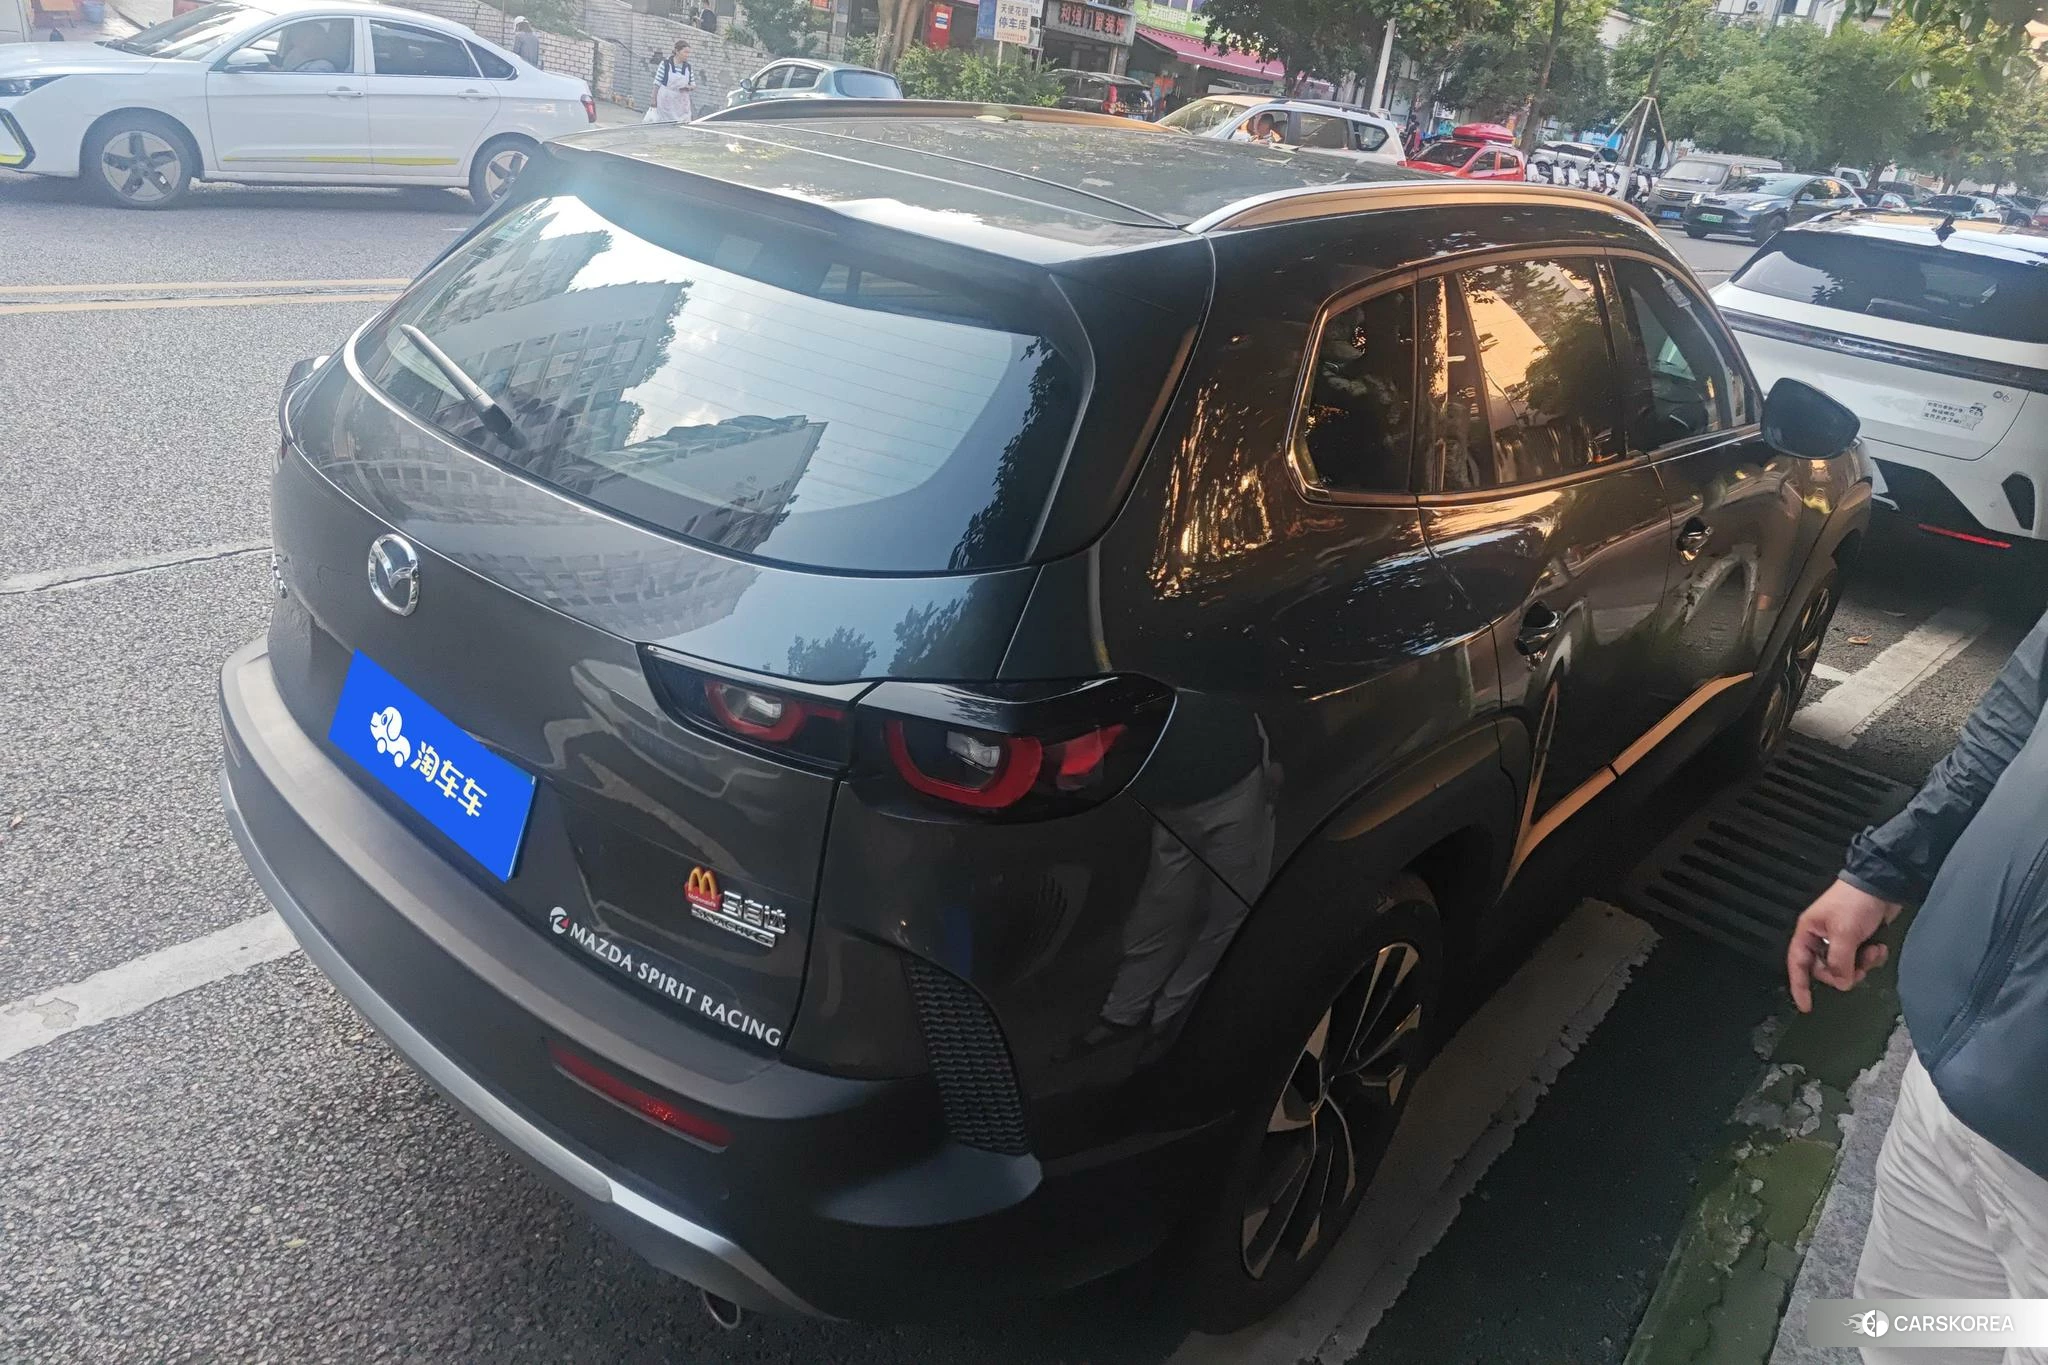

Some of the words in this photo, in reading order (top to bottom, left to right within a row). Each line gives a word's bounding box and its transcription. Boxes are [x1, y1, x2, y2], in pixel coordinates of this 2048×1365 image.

[999, 16, 1027, 31] 停车库
[570, 923, 632, 972] MAZDA
[637, 963, 696, 1004] SPIRIT
[700, 995, 782, 1047] RACING
